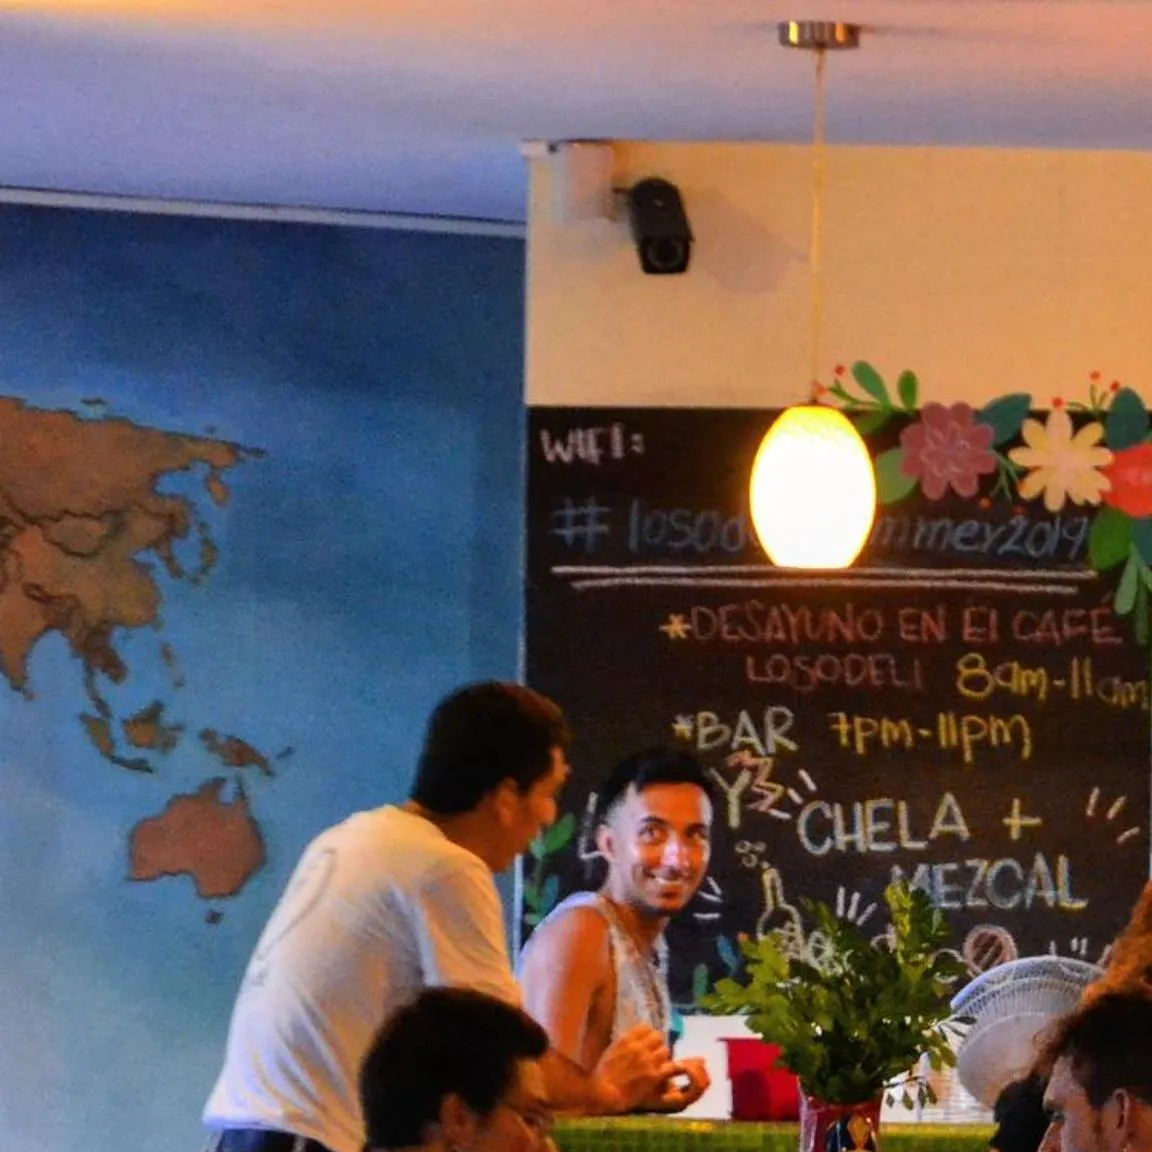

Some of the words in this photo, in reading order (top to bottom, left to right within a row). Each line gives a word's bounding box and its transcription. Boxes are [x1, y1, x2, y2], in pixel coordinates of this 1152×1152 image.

[690, 599, 884, 645] DESAYUNO
[899, 604, 947, 644] EN
[745, 652, 923, 693] LOSODELI
[696, 705, 799, 756] BAR
[797, 791, 971, 856] CHELA
